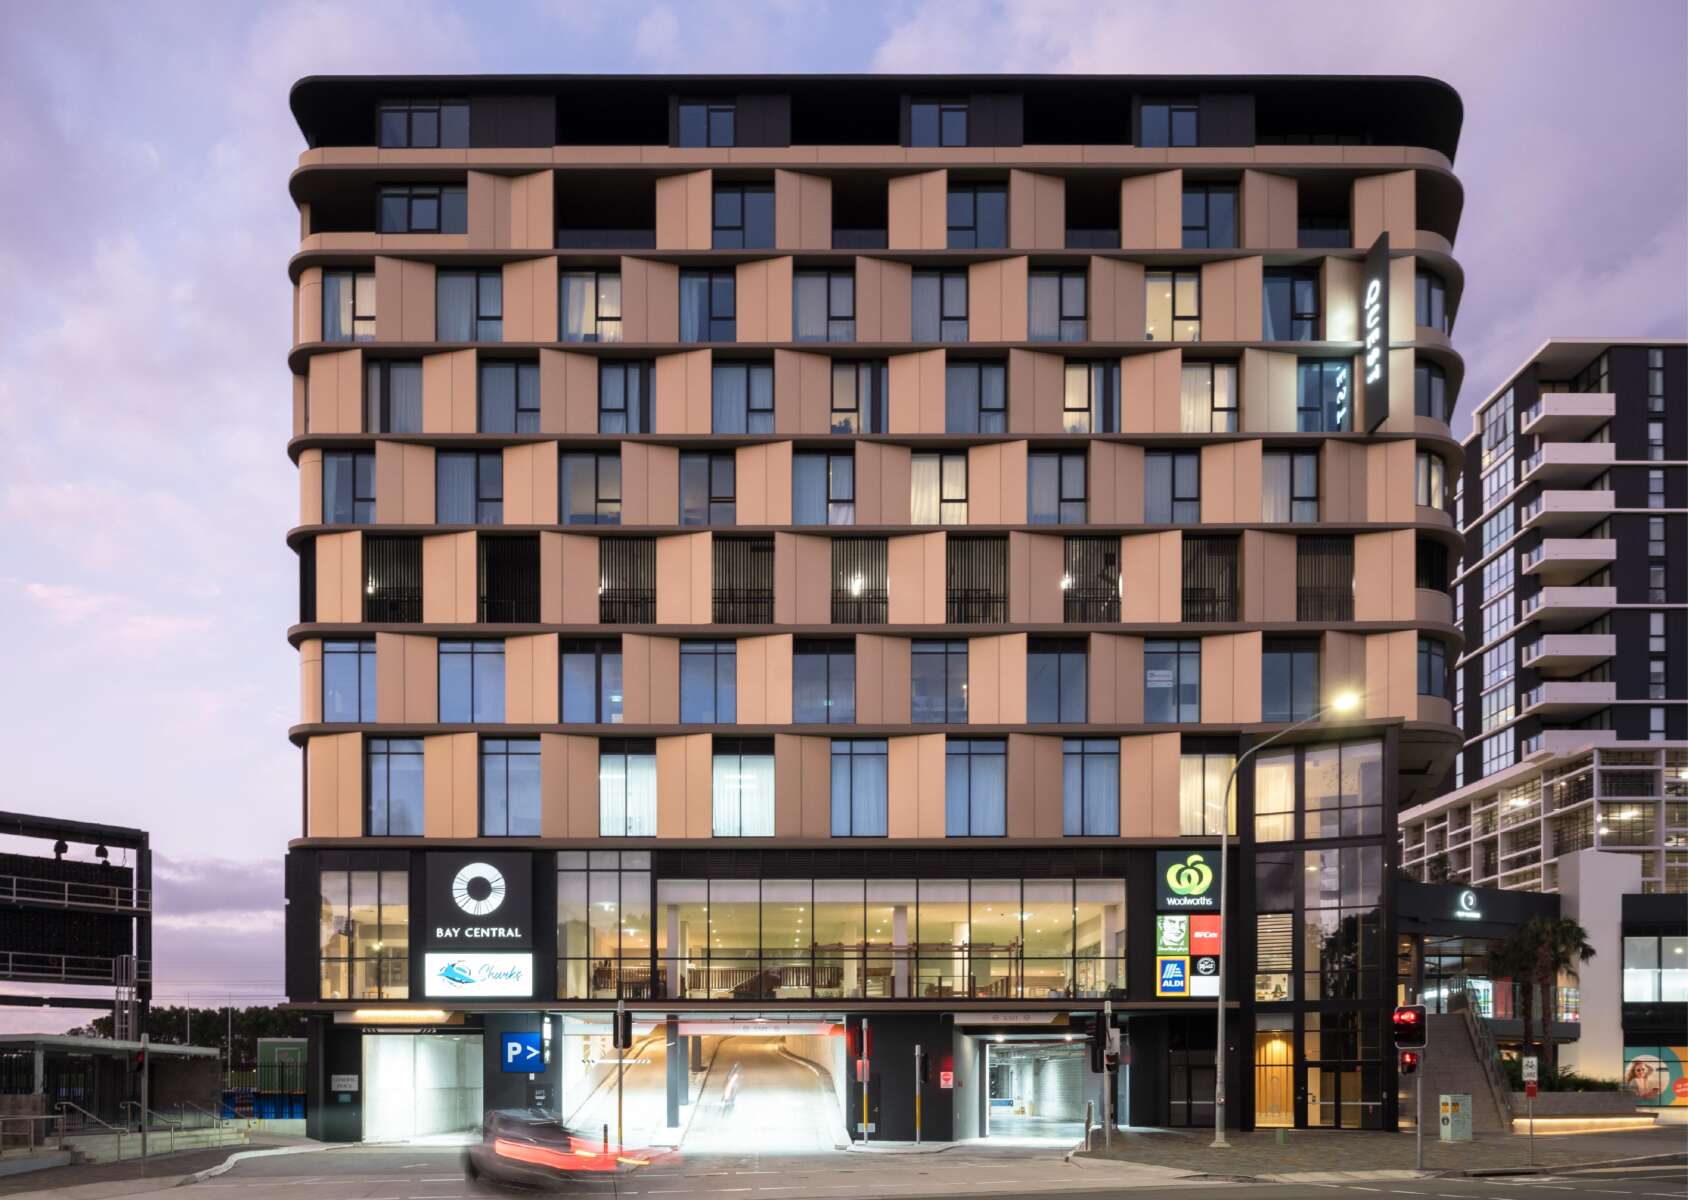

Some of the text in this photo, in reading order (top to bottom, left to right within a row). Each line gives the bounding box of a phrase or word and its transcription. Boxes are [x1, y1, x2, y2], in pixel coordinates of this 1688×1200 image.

[1365, 279, 1380, 384] QUEST
[1166, 896, 1213, 905] Woolworths
[436, 927, 522, 938] BAY CENTRAL
[478, 963, 523, 982] Sharks
[1162, 979, 1184, 987] ALDI
[507, 1041, 522, 1063] P
